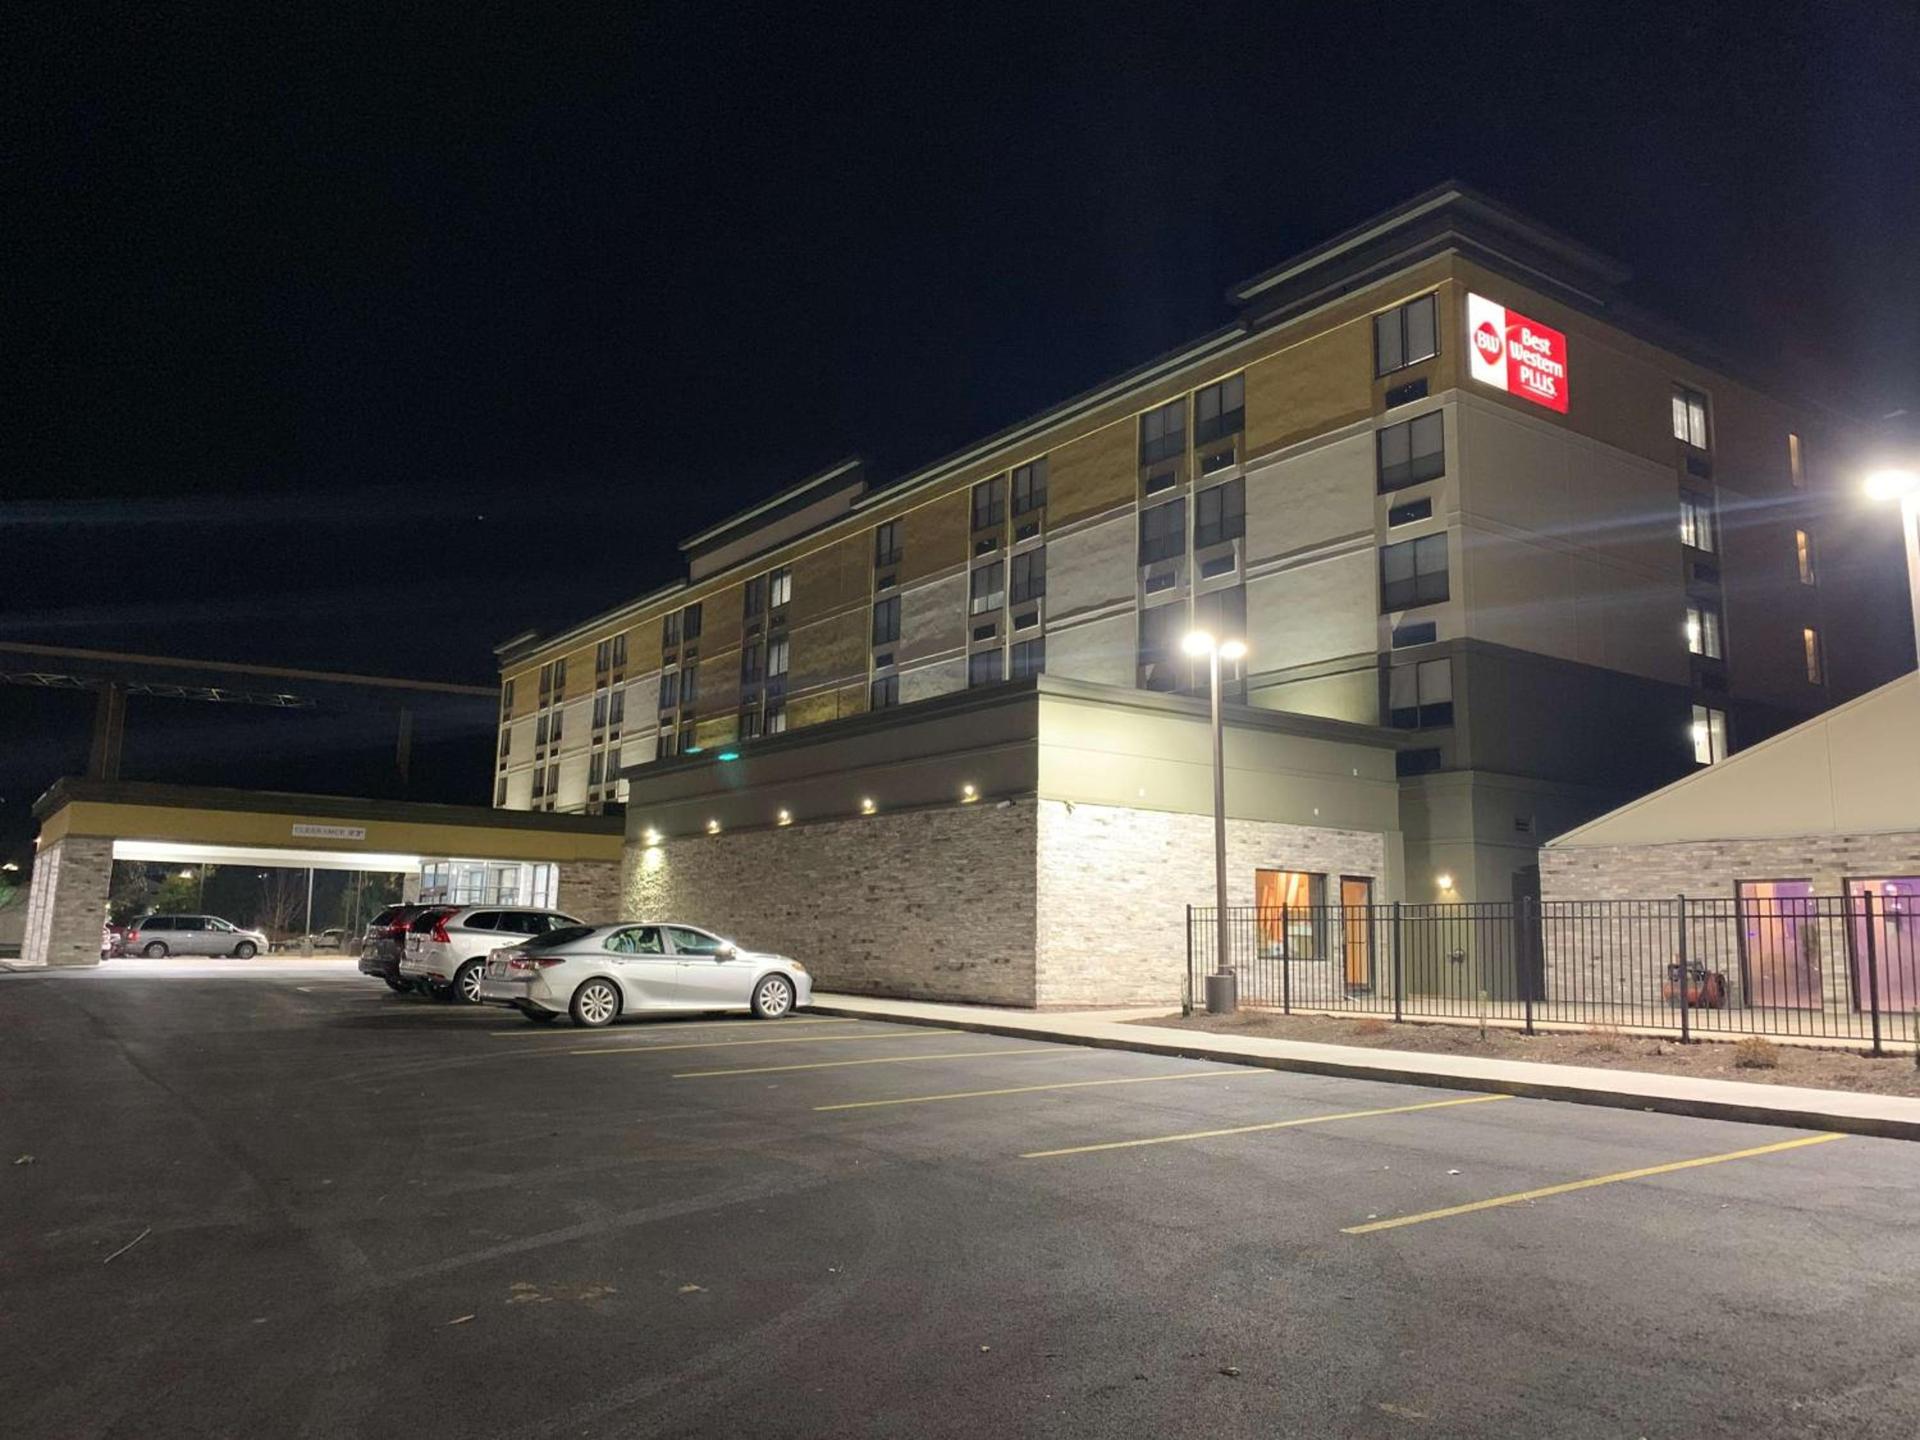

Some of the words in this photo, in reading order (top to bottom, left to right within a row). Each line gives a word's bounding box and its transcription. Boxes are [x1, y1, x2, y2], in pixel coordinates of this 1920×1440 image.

[1477, 330, 1499, 353] BW
[1521, 327, 1551, 355] Best
[1509, 340, 1563, 378] Western
[1520, 365, 1557, 395] PLUS
